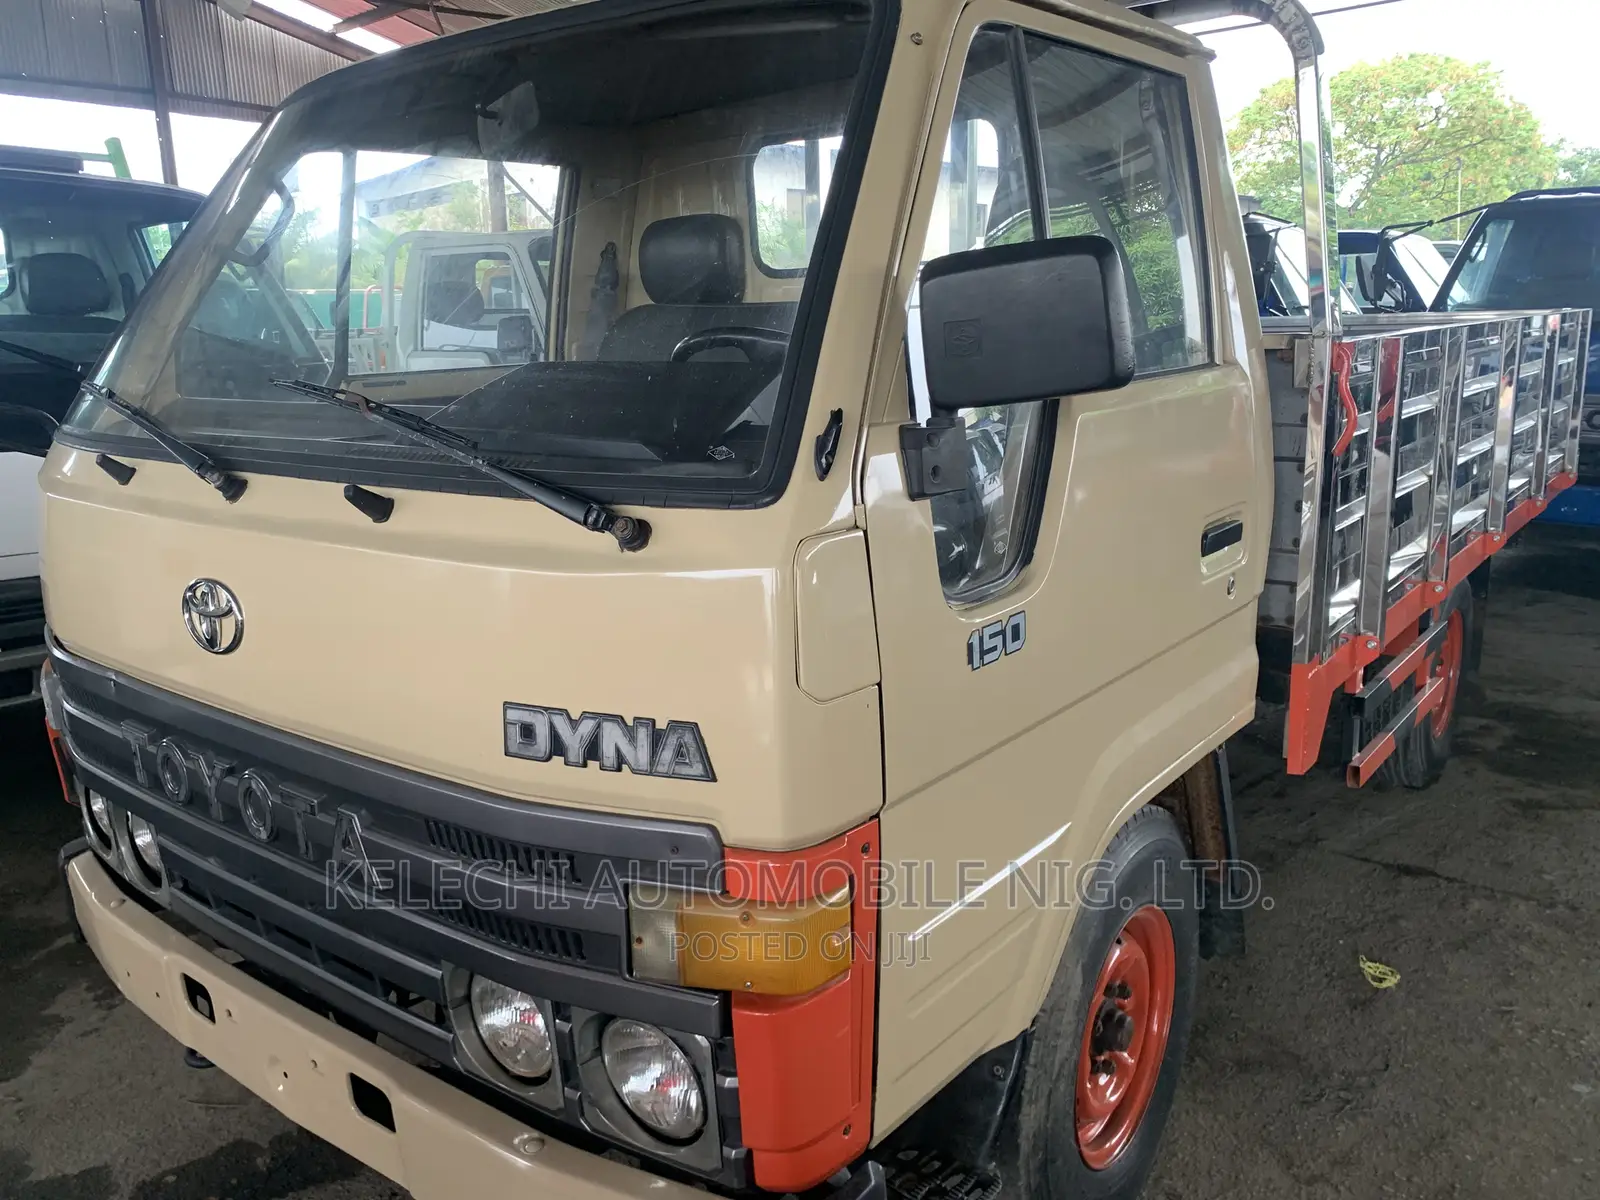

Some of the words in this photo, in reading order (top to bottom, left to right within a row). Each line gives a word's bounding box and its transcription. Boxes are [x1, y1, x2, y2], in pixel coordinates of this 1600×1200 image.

[967, 610, 1026, 671] 150
[503, 701, 717, 782] DYNA
[120, 719, 383, 890] TOYOTA
